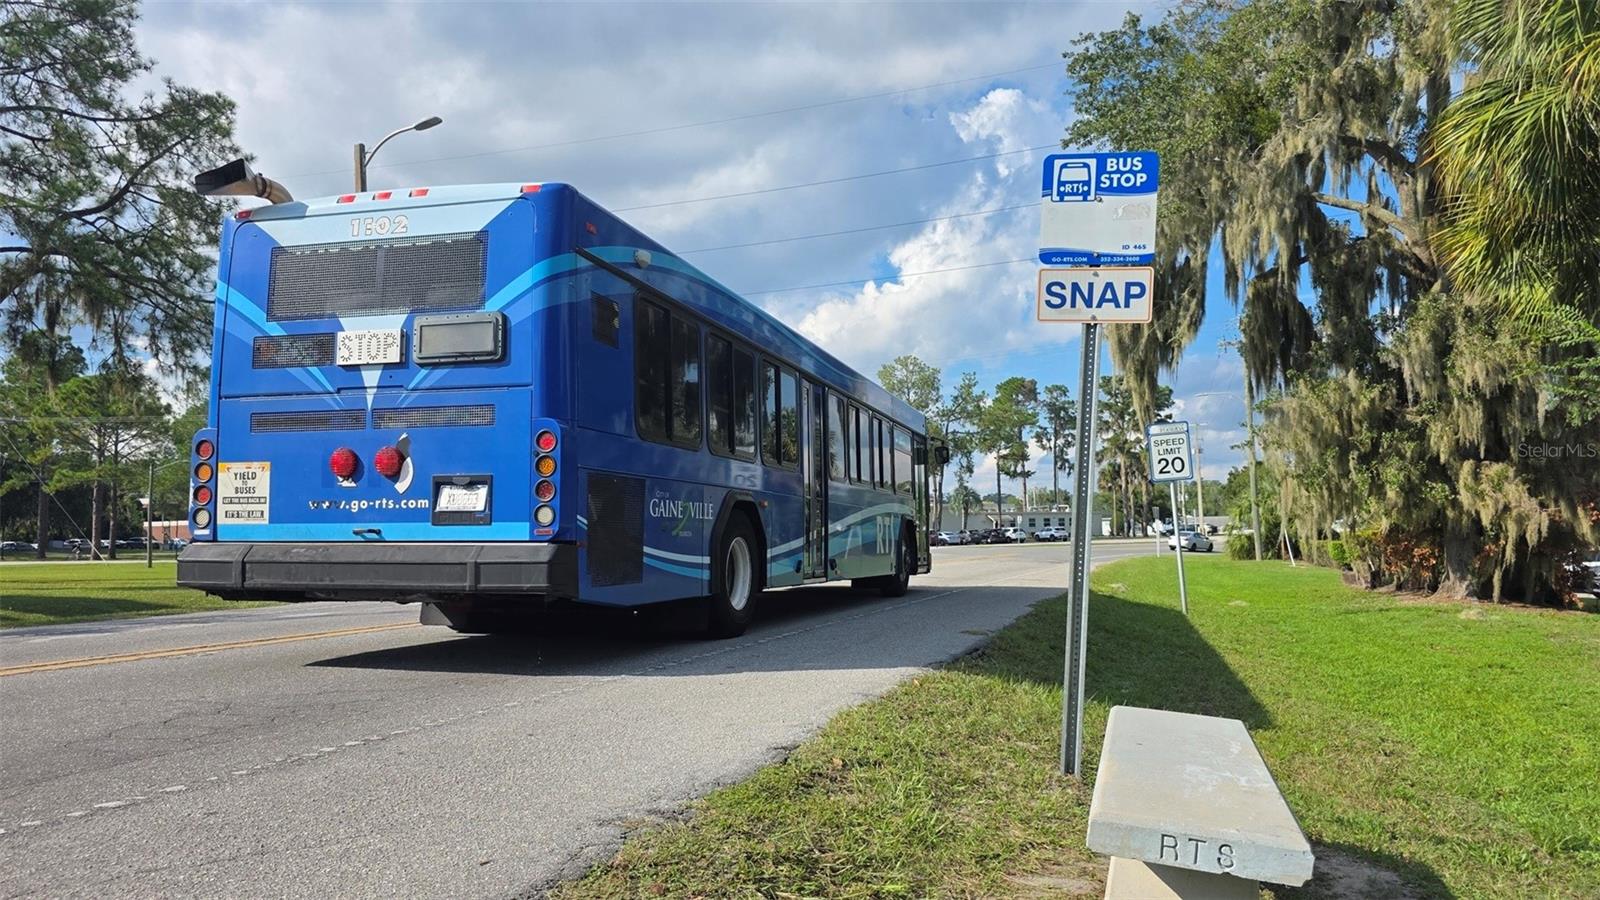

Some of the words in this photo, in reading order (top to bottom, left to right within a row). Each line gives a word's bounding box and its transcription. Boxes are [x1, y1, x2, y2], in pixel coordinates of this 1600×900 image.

[1106, 157, 1142, 171] BUS
[1064, 182, 1084, 193] RTS
[1100, 173, 1147, 188] STOP
[1044, 281, 1147, 309] SNAP
[341, 332, 397, 362] STOP
[1153, 438, 1185, 447] SPEED
[1157, 447, 1181, 456] LIMIT
[1157, 456, 1185, 474] 20
[233, 471, 257, 480] YIELD
[234, 486, 256, 494] BUSES
[1160, 834, 1234, 869] RTS
